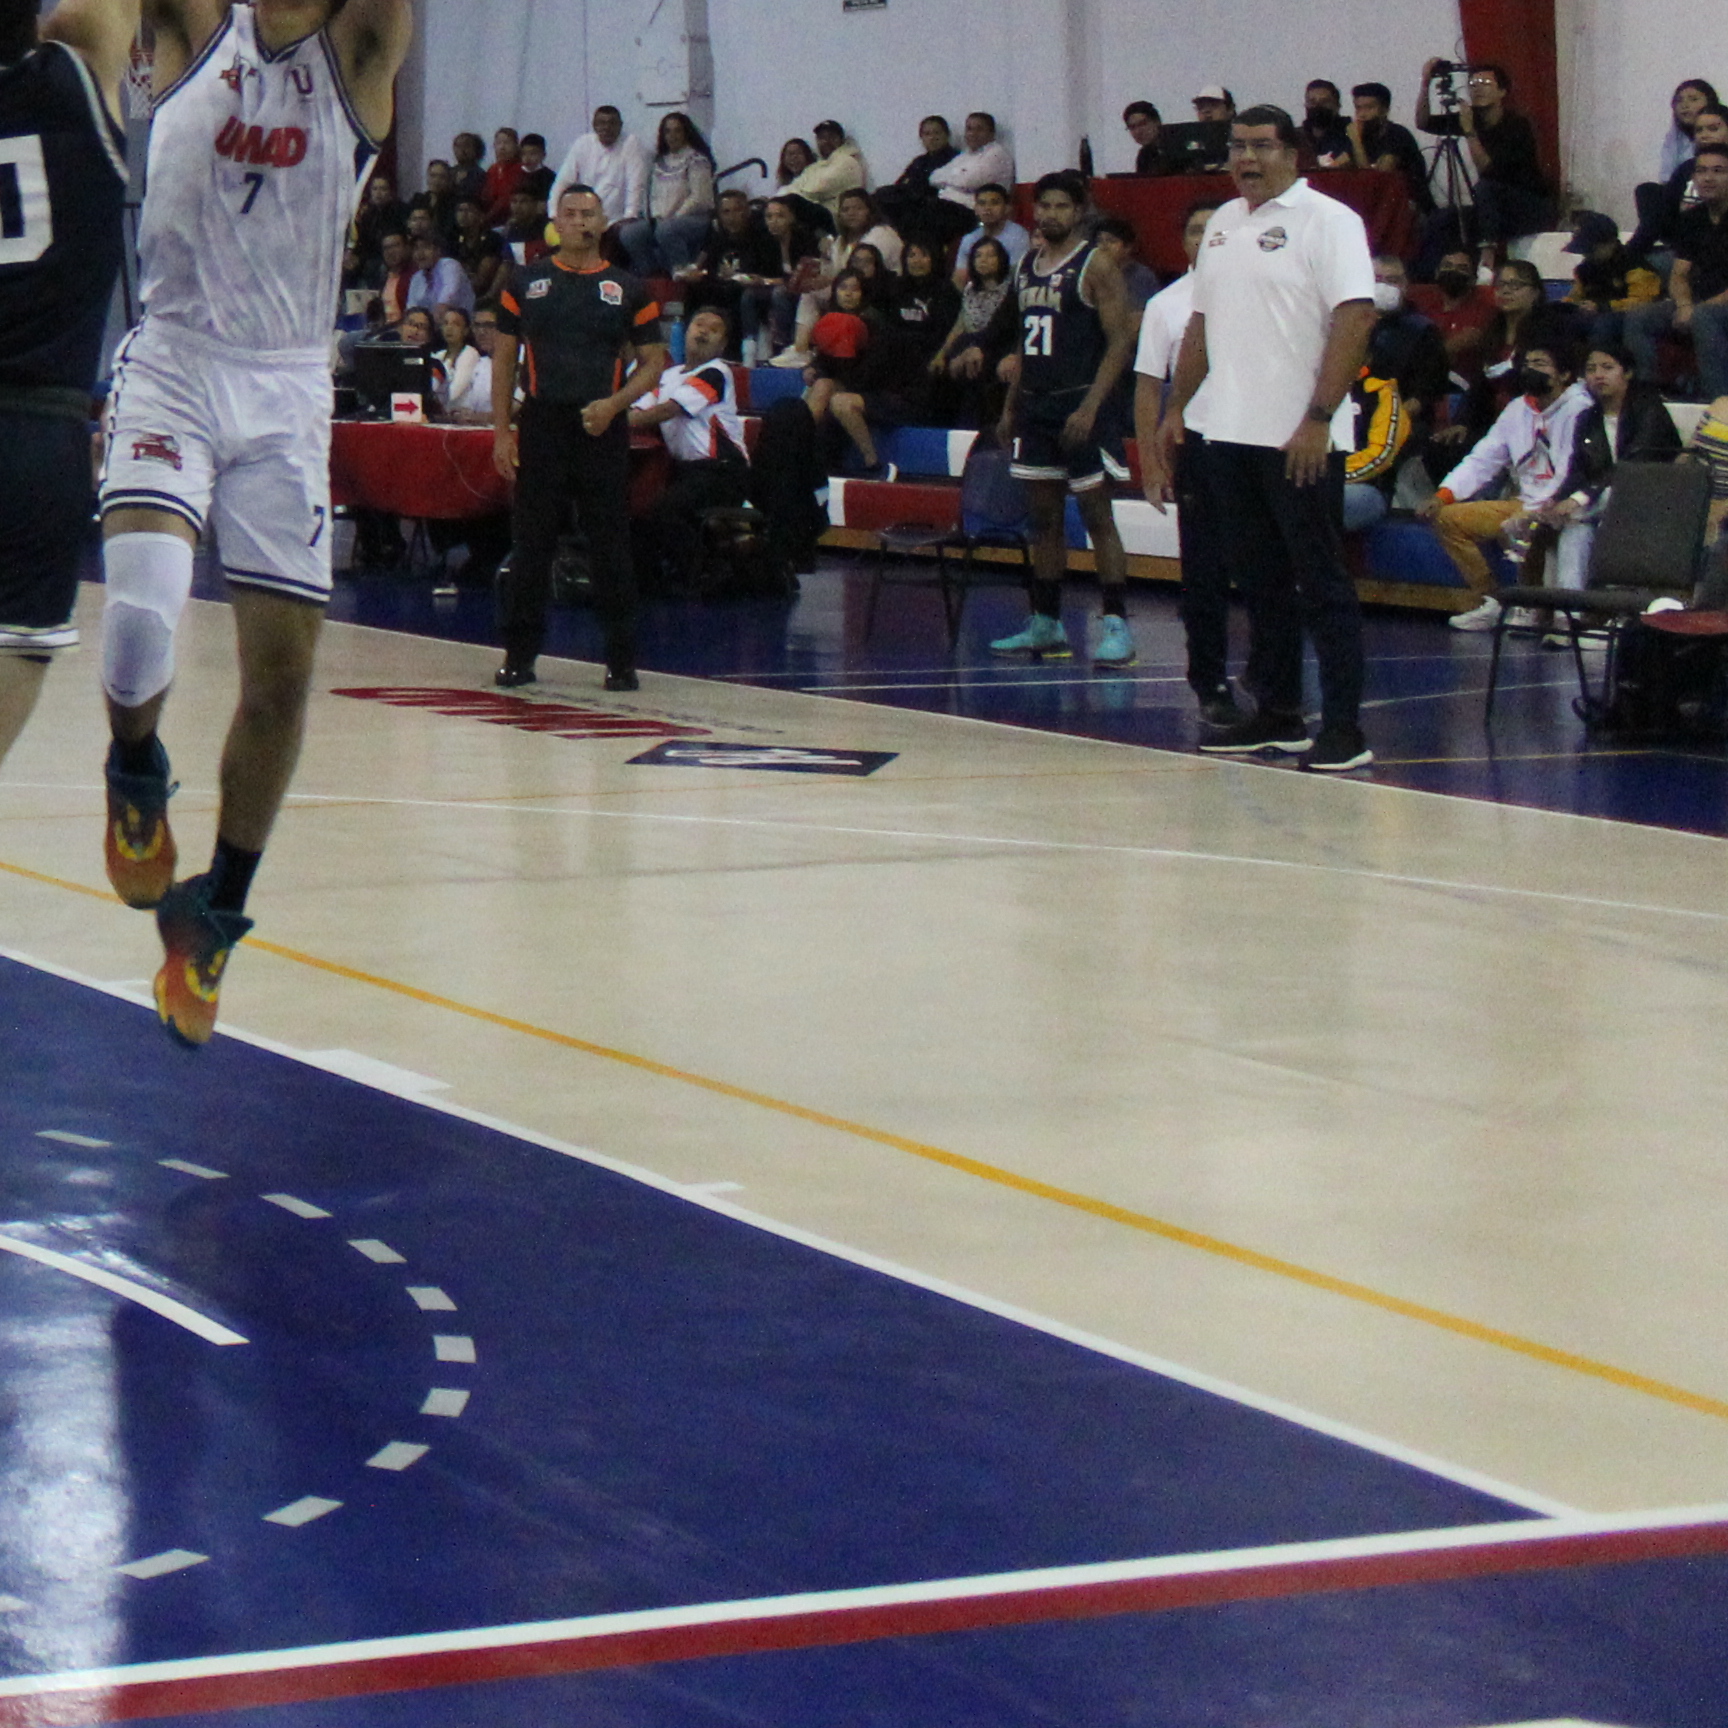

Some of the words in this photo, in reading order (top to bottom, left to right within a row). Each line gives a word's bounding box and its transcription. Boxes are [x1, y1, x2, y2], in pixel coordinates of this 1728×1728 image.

[215, 116, 308, 168] UMAD
[240, 172, 264, 214] 7
[1024, 315, 1053, 356] 21
